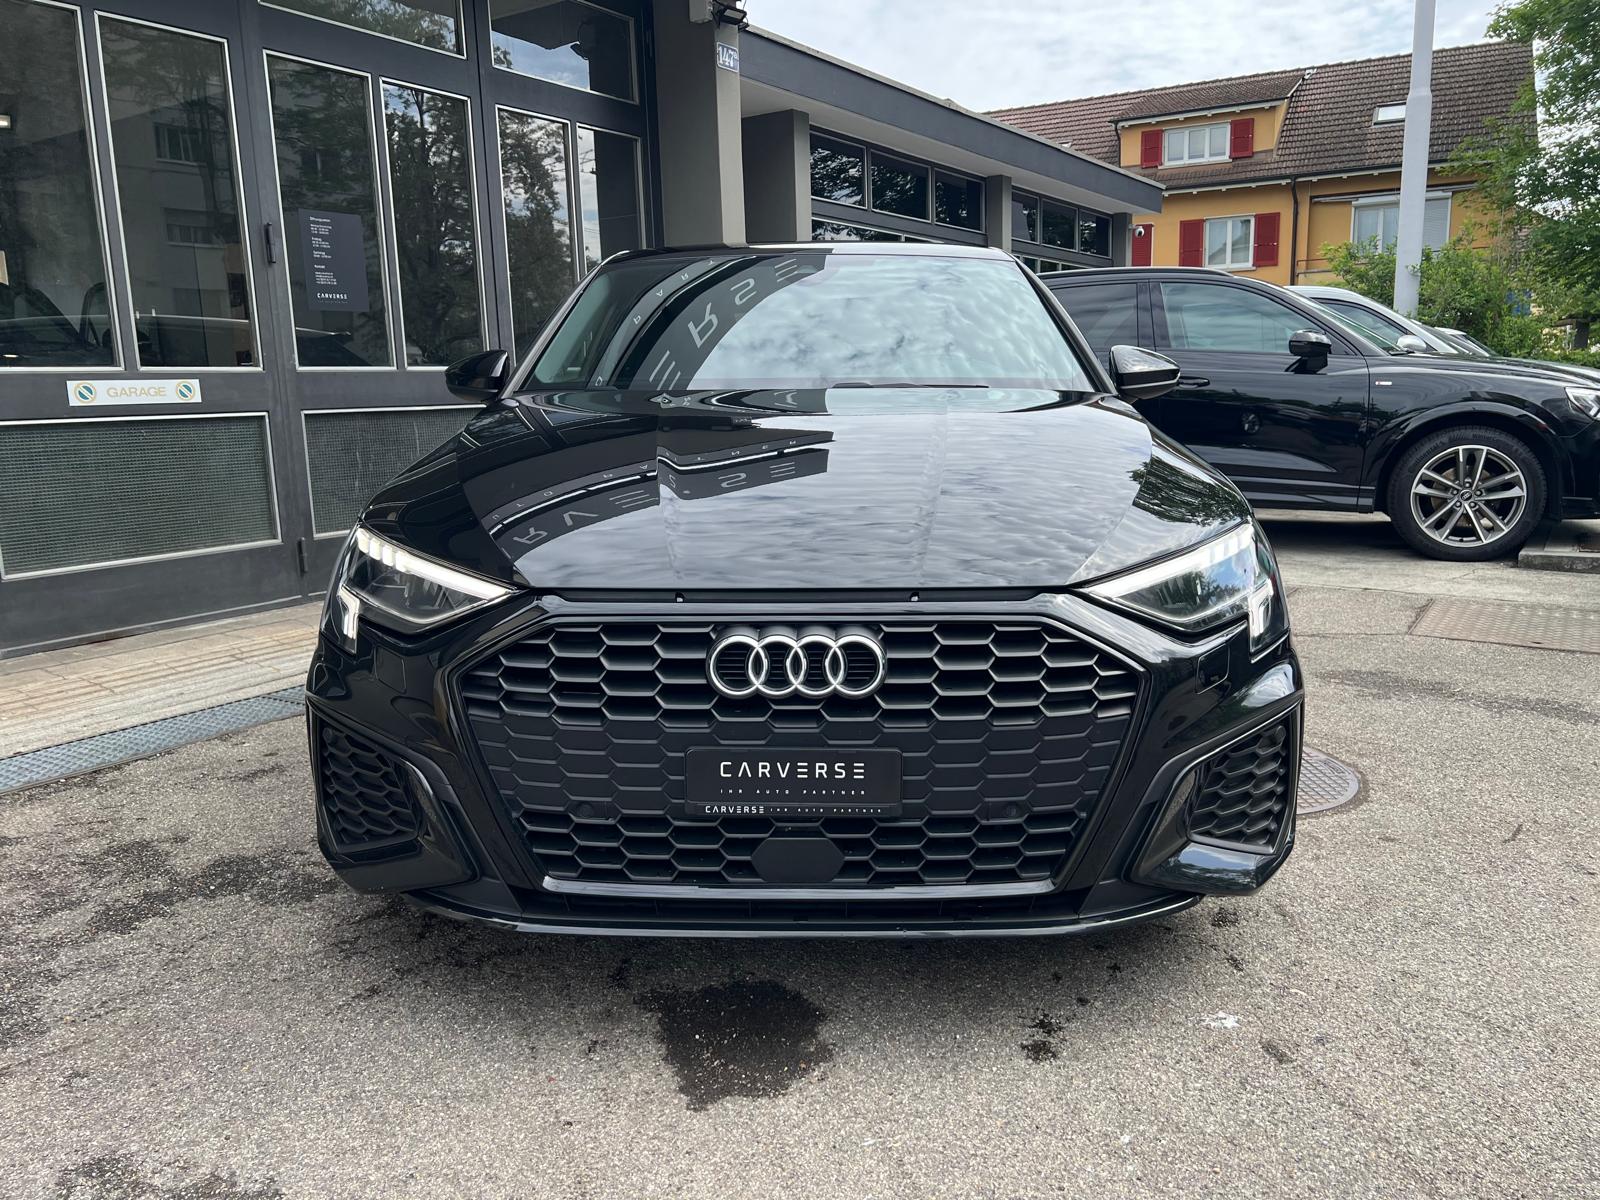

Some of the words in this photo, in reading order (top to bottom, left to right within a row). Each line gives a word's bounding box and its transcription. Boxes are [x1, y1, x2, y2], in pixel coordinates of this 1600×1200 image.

[106, 386, 167, 398] GARAGE
[720, 761, 865, 779] CARVERSE
[705, 805, 765, 814] CARVERSE
